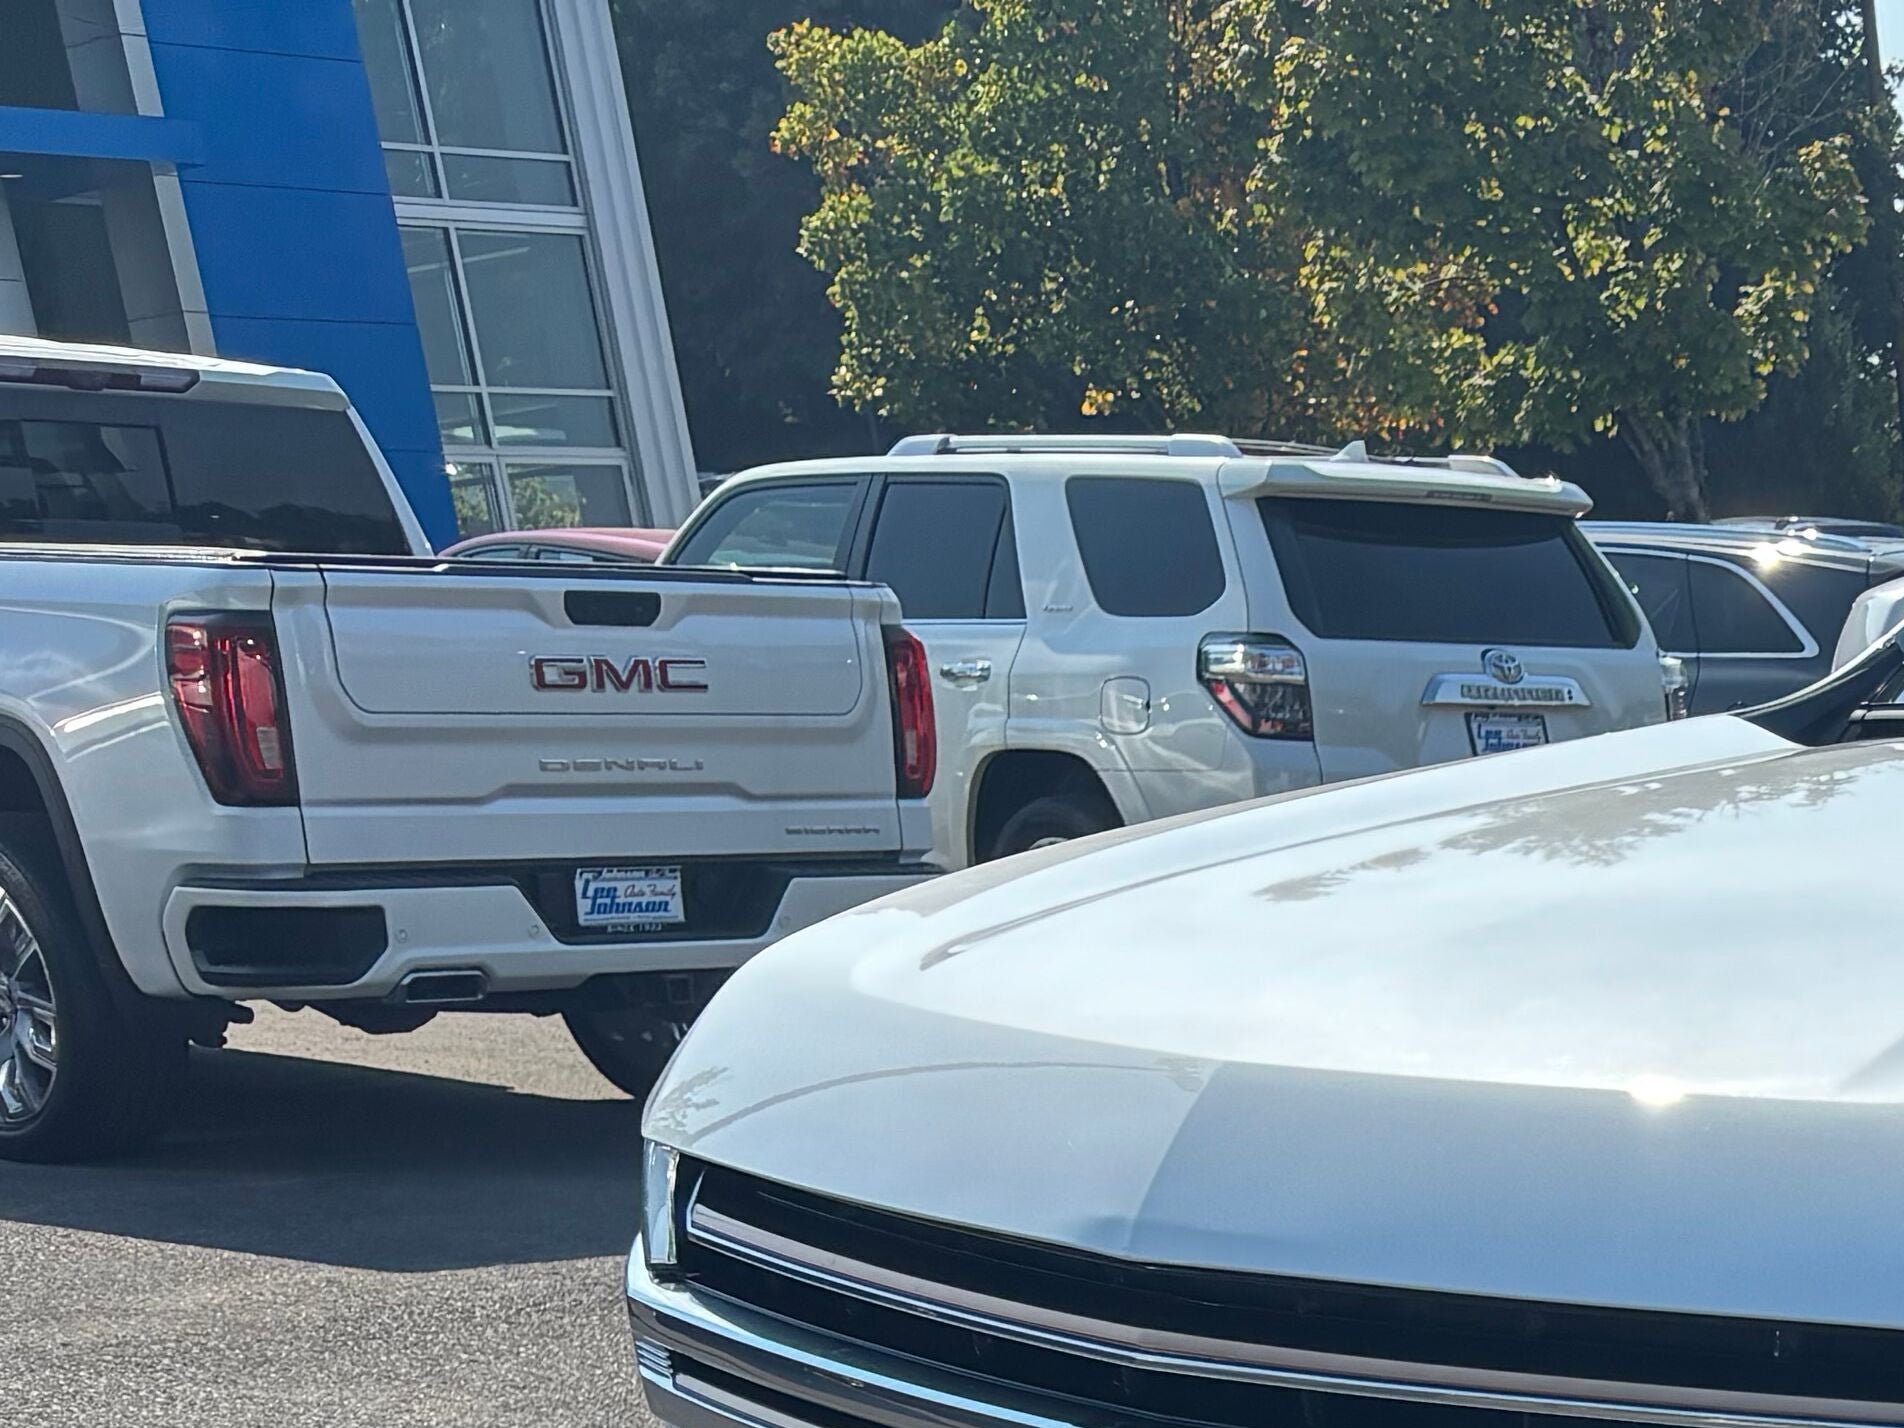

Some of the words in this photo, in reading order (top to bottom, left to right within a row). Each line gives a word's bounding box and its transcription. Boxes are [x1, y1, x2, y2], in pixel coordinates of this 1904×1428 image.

[529, 655, 709, 693] GMC
[538, 758, 704, 772] DENALI
[581, 878, 619, 899] Lee
[584, 895, 671, 915] Johnson
